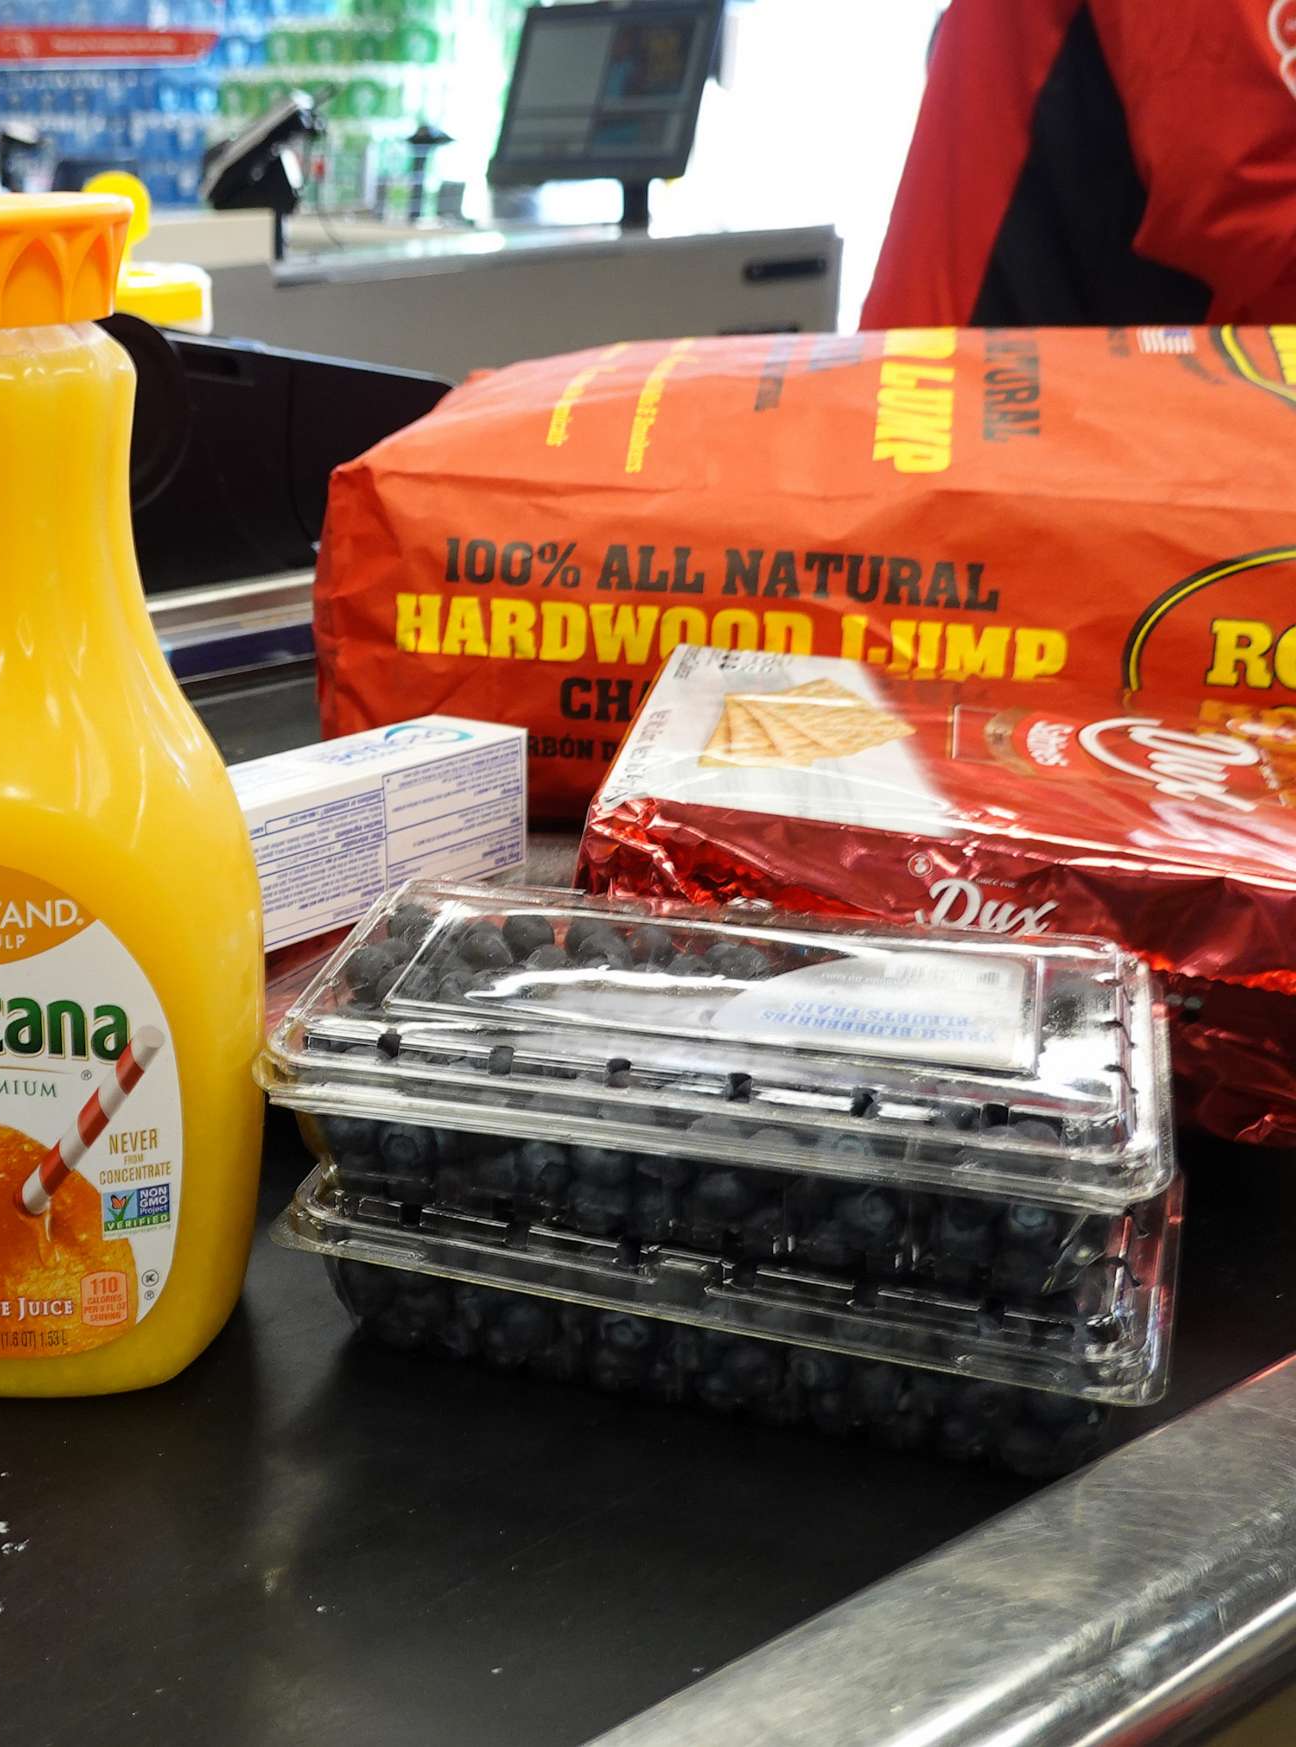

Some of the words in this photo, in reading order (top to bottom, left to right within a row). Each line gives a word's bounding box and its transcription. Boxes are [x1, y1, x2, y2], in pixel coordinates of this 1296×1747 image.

[871, 361, 956, 474] LUMP
[443, 537, 582, 588] 100%
[596, 544, 705, 594] ALL
[721, 549, 1001, 612] NATURAL
[395, 592, 816, 665] HARDWOOD
[841, 614, 1069, 682] LUMP
[914, 877, 1061, 937] Dux
[108, 1127, 159, 1156] NEVER
[123, 1152, 144, 1165] FROM
[99, 1160, 172, 1187] CONCENTRATE
[139, 1186, 169, 1200] NON
[139, 1194, 169, 1209] GMO
[106, 1214, 170, 1231] VERIFIED
[139, 1203, 169, 1217] Project
[90, 1276, 118, 1295] 110
[18, 1296, 75, 1322] JUICE
